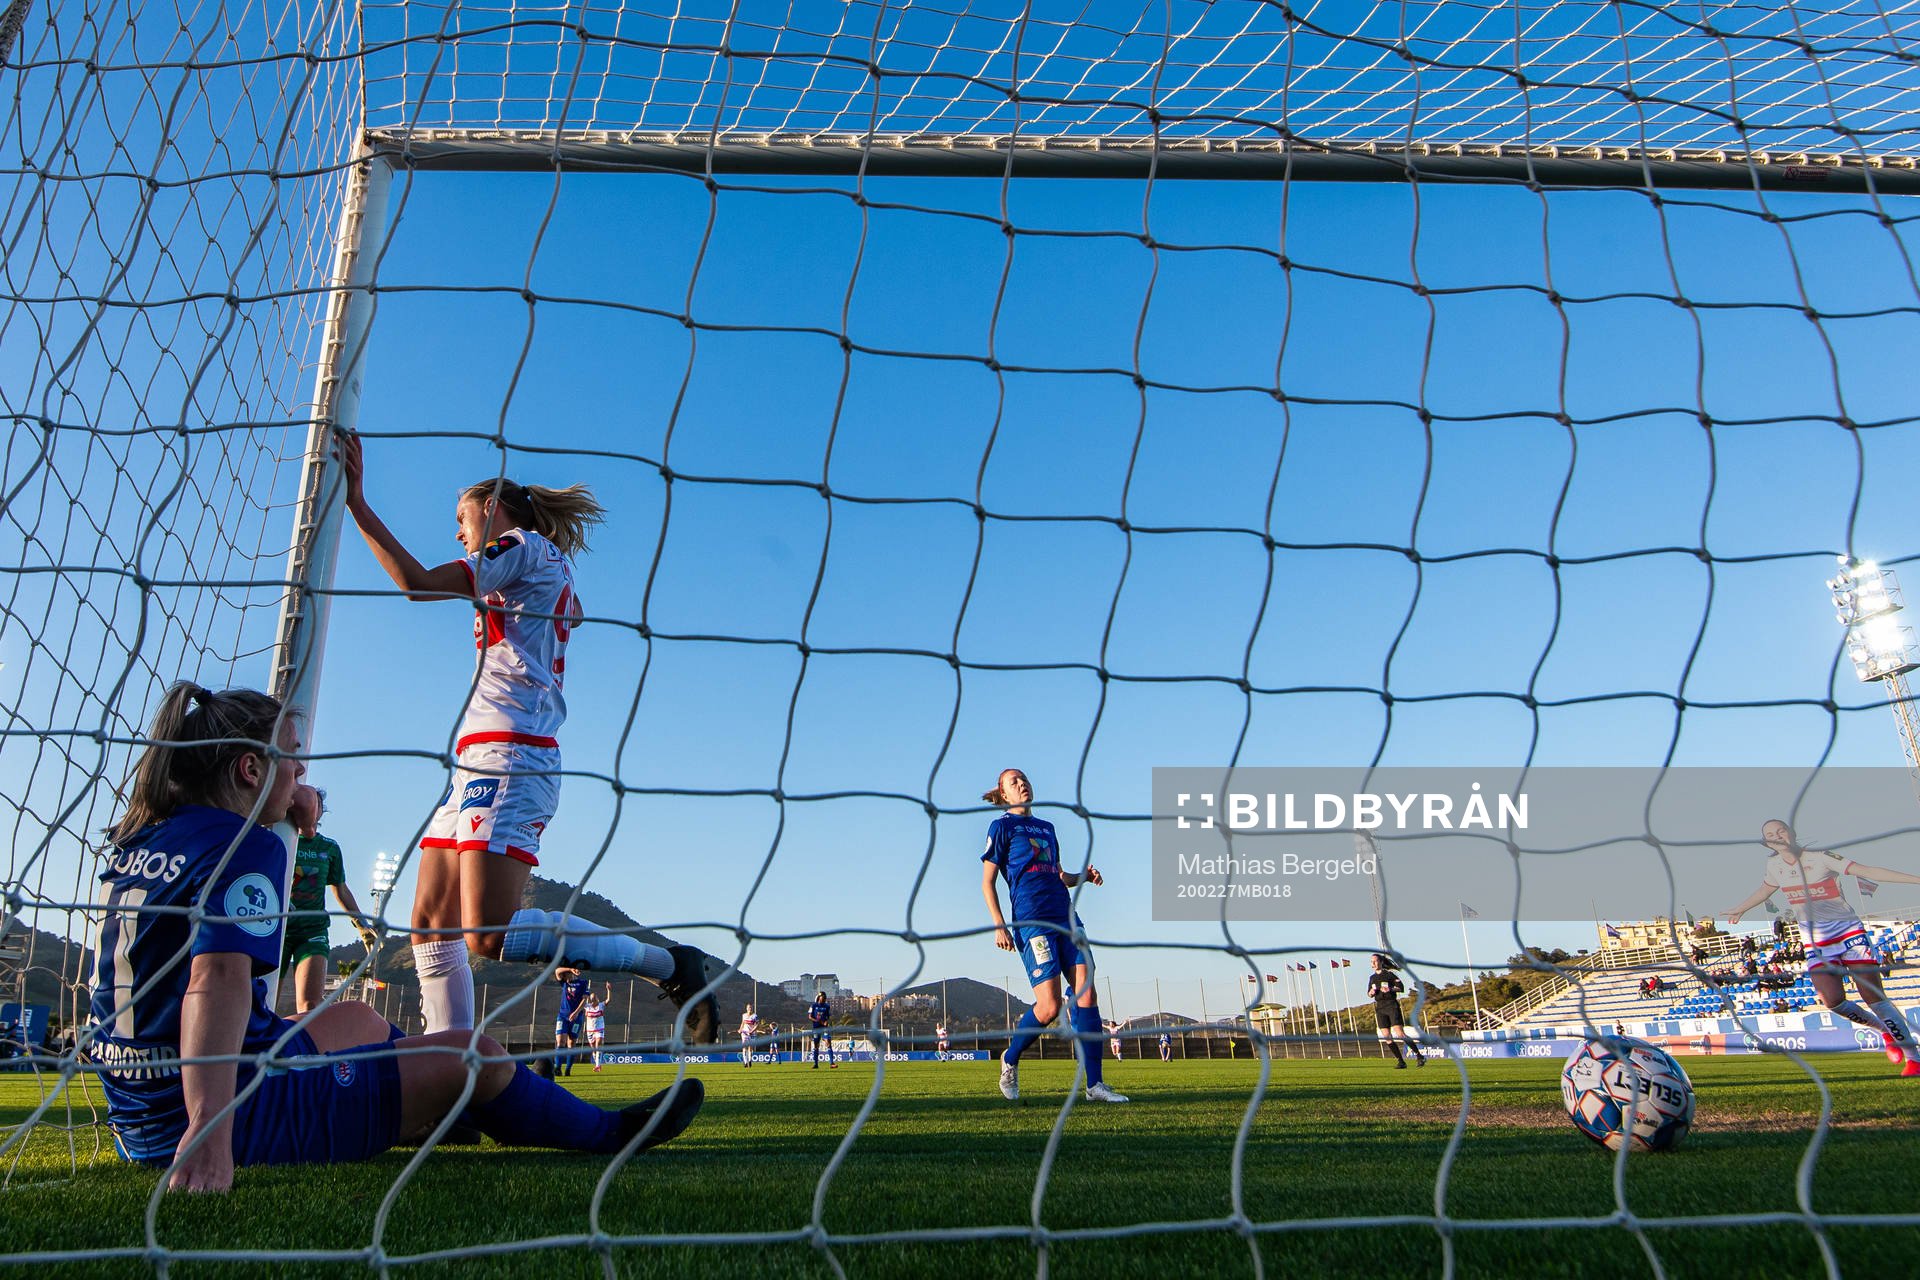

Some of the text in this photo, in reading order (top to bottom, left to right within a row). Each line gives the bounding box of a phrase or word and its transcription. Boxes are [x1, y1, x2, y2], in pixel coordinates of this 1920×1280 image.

[1471, 1046, 1493, 1057] OBOS
[1527, 1045, 1552, 1057] OBOS
[617, 1055, 643, 1064] OBOS
[684, 1055, 709, 1063] OBOS
